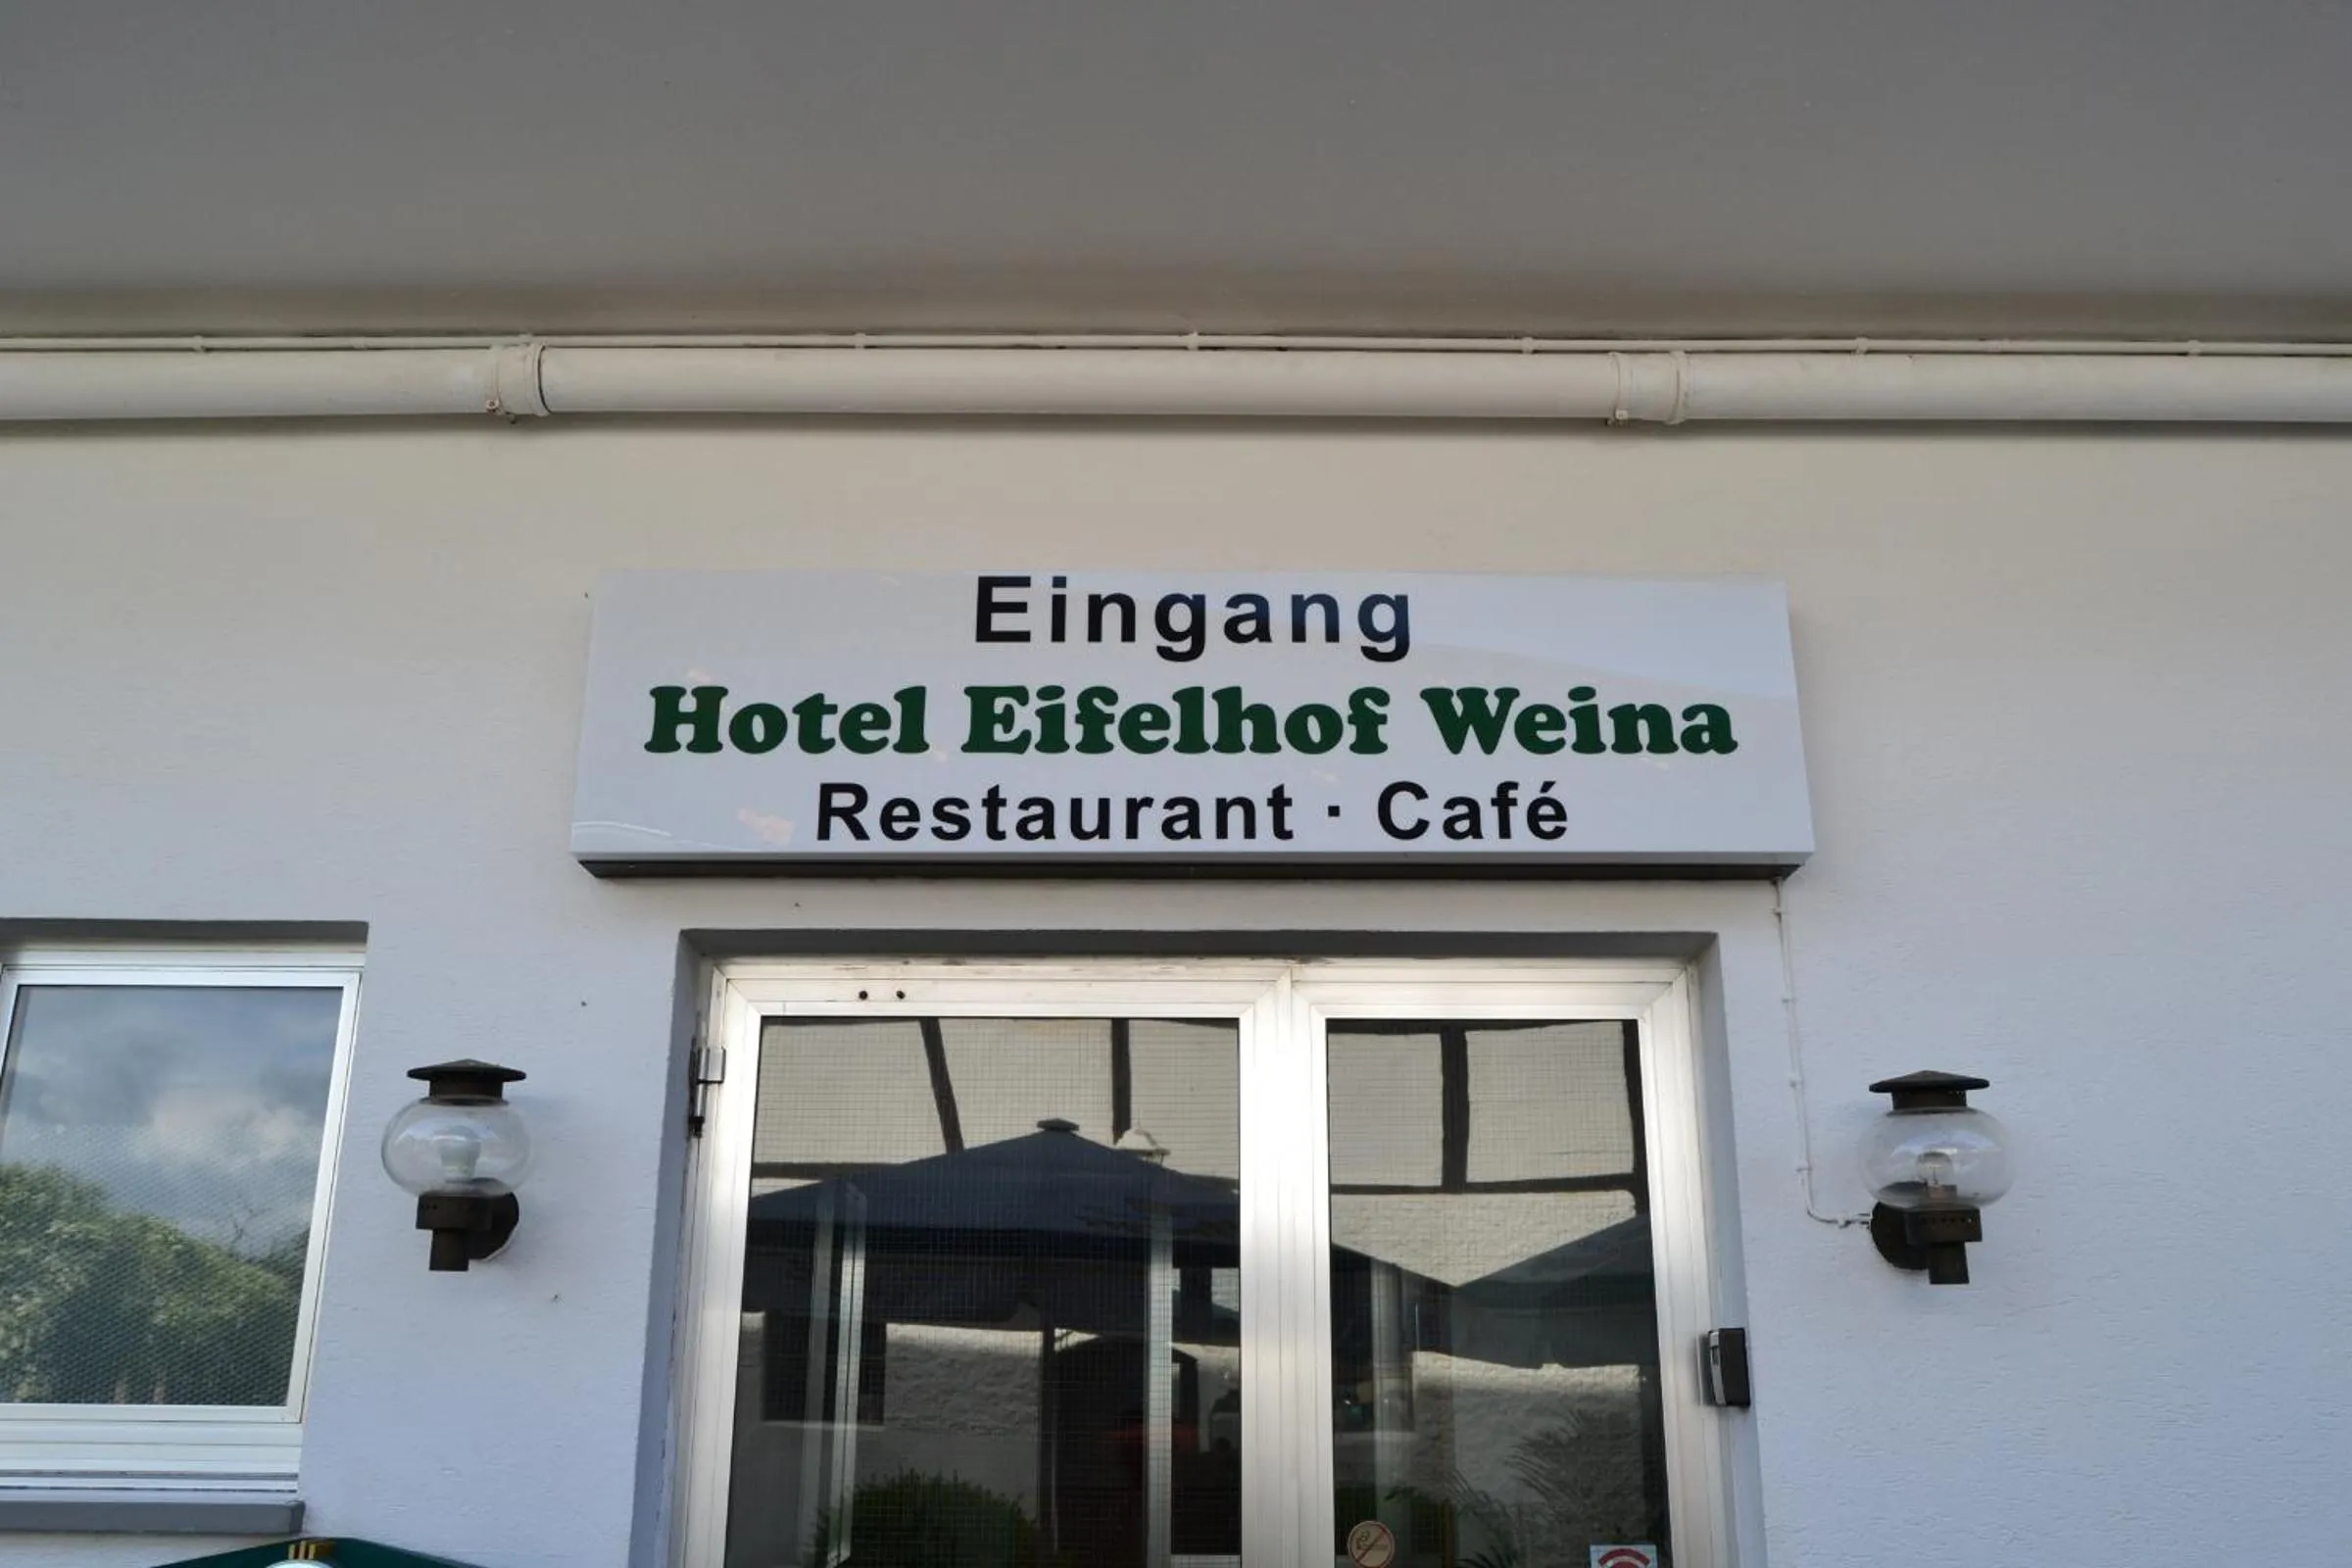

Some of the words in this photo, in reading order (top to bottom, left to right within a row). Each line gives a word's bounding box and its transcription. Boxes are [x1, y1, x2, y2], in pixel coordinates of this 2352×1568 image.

[975, 575, 1411, 663] Eingang
[643, 685, 930, 755] Hotel
[960, 684, 1392, 756] Eifelhof
[1419, 685, 1739, 756] Weina
[816, 782, 1295, 842] Restaurant
[1377, 780, 1568, 841] Café
